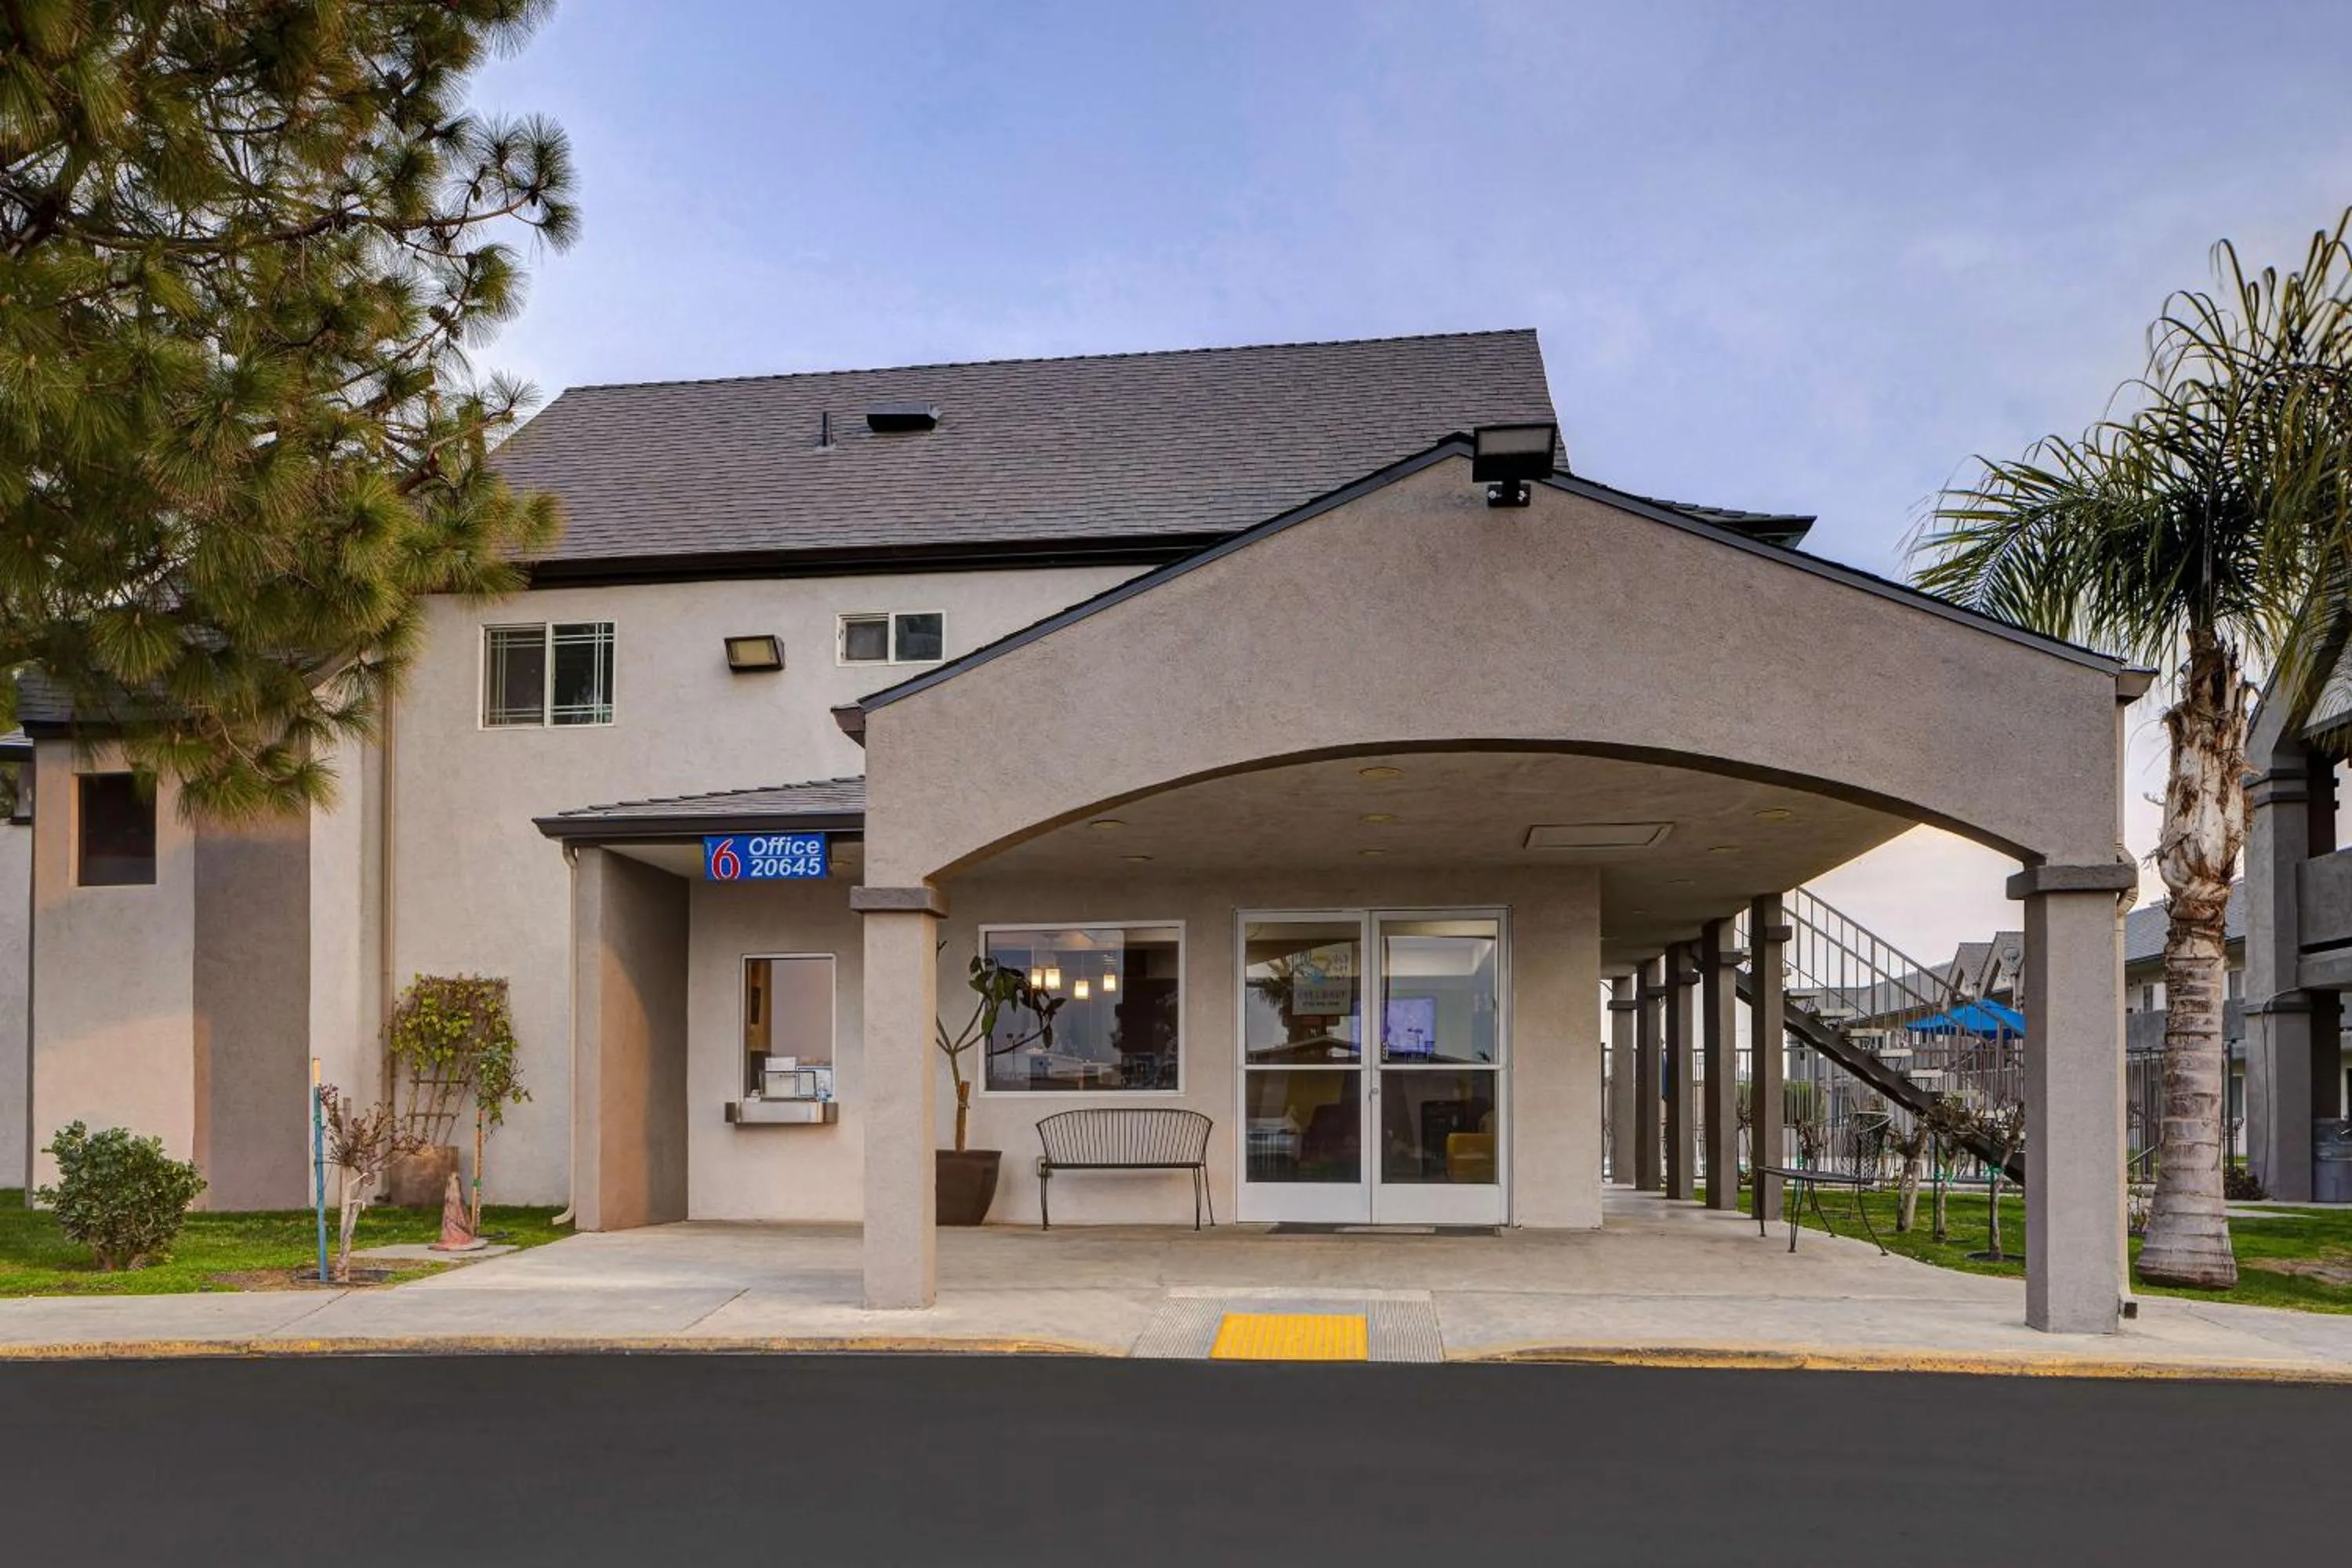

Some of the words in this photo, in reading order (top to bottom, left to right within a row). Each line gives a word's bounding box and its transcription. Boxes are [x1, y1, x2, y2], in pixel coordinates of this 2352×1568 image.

[749, 837, 820, 855] Office
[711, 838, 741, 879] 6
[750, 858, 821, 877] 20645
